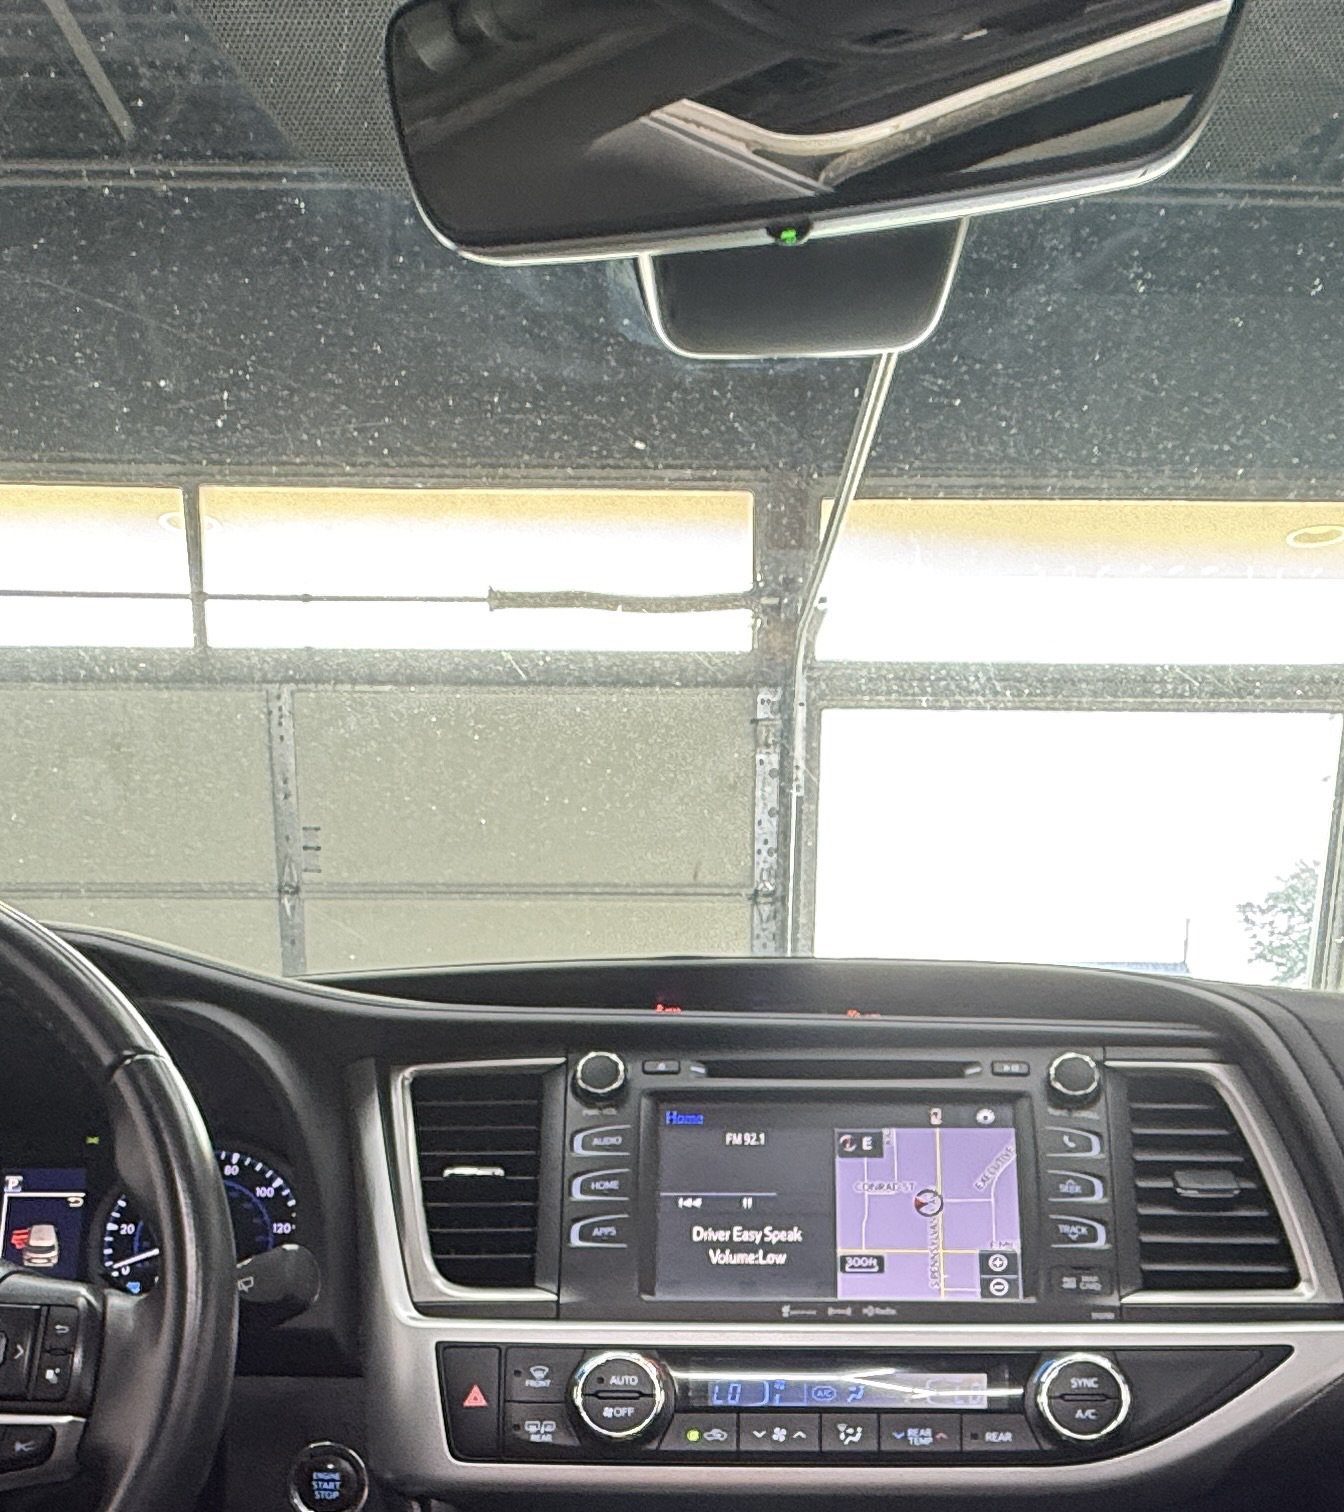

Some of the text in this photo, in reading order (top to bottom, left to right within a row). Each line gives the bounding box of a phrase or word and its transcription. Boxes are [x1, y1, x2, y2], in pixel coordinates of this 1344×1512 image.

[666, 1111, 704, 1124] Home
[592, 1136, 622, 1146] AUDIO
[725, 1132, 765, 1145] FM 92.1
[862, 1136, 872, 1150] E
[223, 1165, 240, 1176] 80
[591, 1180, 619, 1190] HOME
[255, 1186, 275, 1198] 100
[119, 1224, 135, 1235] 20
[272, 1222, 292, 1234] 120
[592, 1226, 616, 1237] APPS
[1057, 1223, 1089, 1235] TRACK
[692, 1226, 803, 1245] Driver Easy Speak
[708, 1249, 787, 1266] Volume:Low
[845, 1257, 879, 1267] 300ft
[525, 1380, 551, 1388] FRONT
[609, 1375, 639, 1385] AUTO
[1070, 1377, 1099, 1388] SYNC
[613, 1407, 635, 1417] OFF
[1075, 1408, 1097, 1419] A/C
[529, 1434, 552, 1442] REAR
[907, 1428, 932, 1437] REAR
[985, 1431, 1012, 1443] REAR
[908, 1437, 933, 1446] TEMP
[312, 1481, 341, 1490] START
[315, 1491, 339, 1500] STOP
